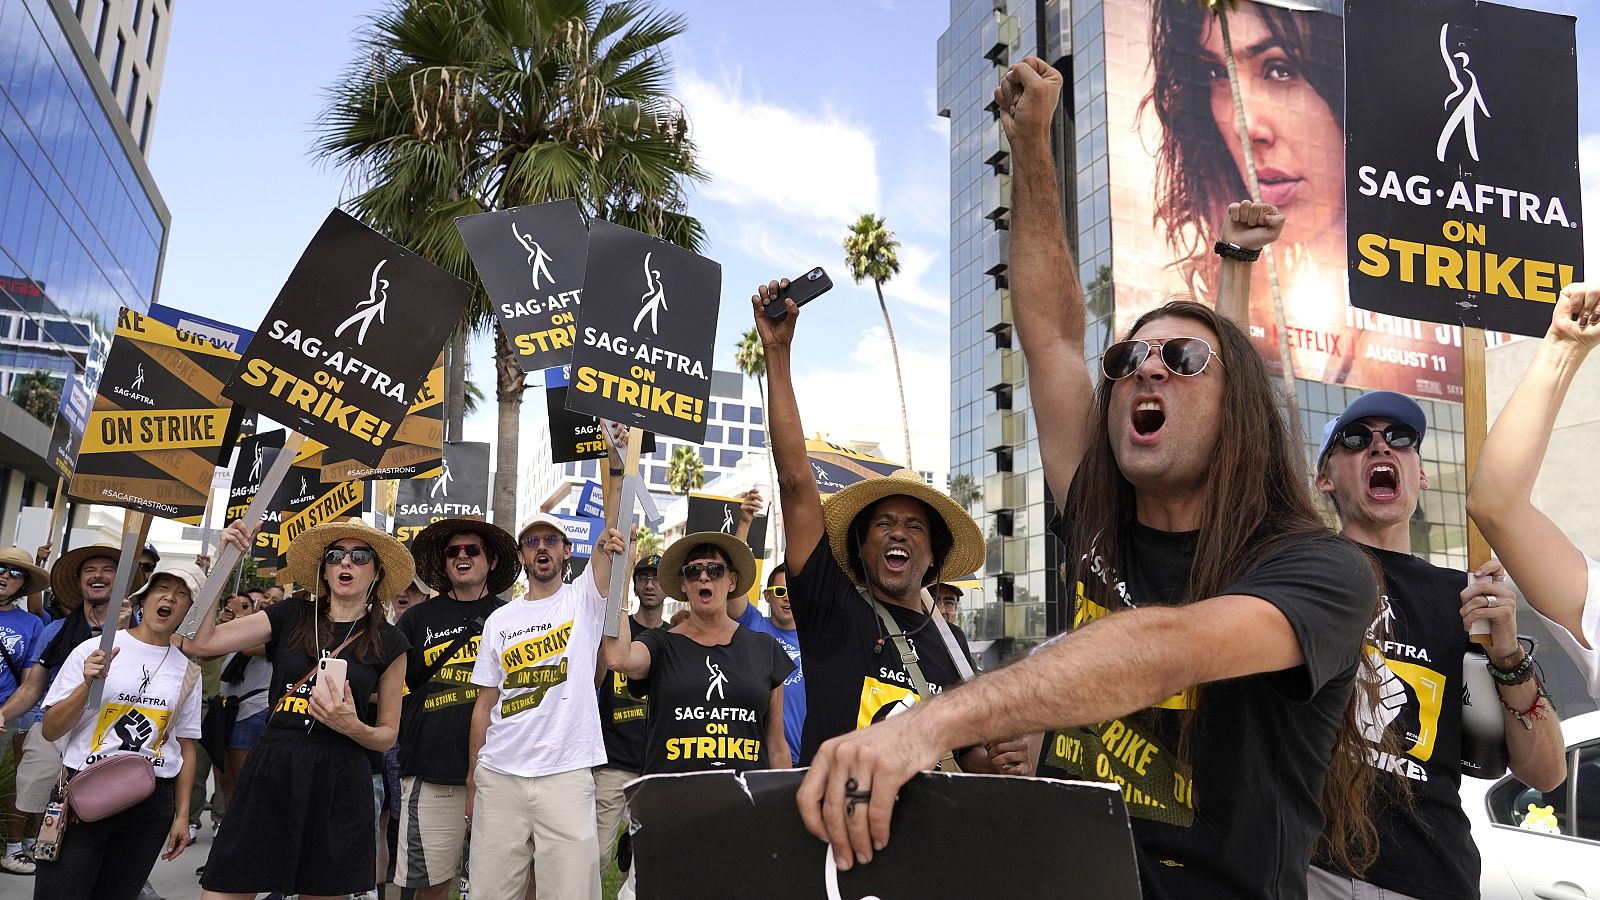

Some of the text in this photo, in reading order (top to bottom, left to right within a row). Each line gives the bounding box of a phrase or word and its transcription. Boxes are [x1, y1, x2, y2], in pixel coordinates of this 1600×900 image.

[1442, 220, 1486, 246] ON
[551, 312, 575, 325] ON
[1365, 343, 1447, 372] AUGUST 11
[314, 371, 345, 394] ON
[630, 365, 656, 383] ON
[240, 358, 392, 446] STRIKE!
[576, 366, 704, 423] STRIKE!
[101, 417, 133, 445] ON
[140, 415, 216, 443] STRIKE
[347, 466, 416, 476] #SAGAFTRASTRONG
[102, 488, 178, 513] #SAGAFTRASTRONG
[287, 515, 306, 542] ON
[309, 480, 358, 527] STRIKE
[504, 648, 523, 668] ON
[524, 626, 571, 661] STRIKE
[440, 667, 454, 680] ON
[518, 671, 530, 684] ON
[424, 692, 457, 708] ON STRIKE
[502, 694, 536, 714] ON STRIKE
[613, 708, 644, 720] ON STRIKE
[705, 723, 728, 735] ON
[665, 735, 760, 762] STRIKE!
